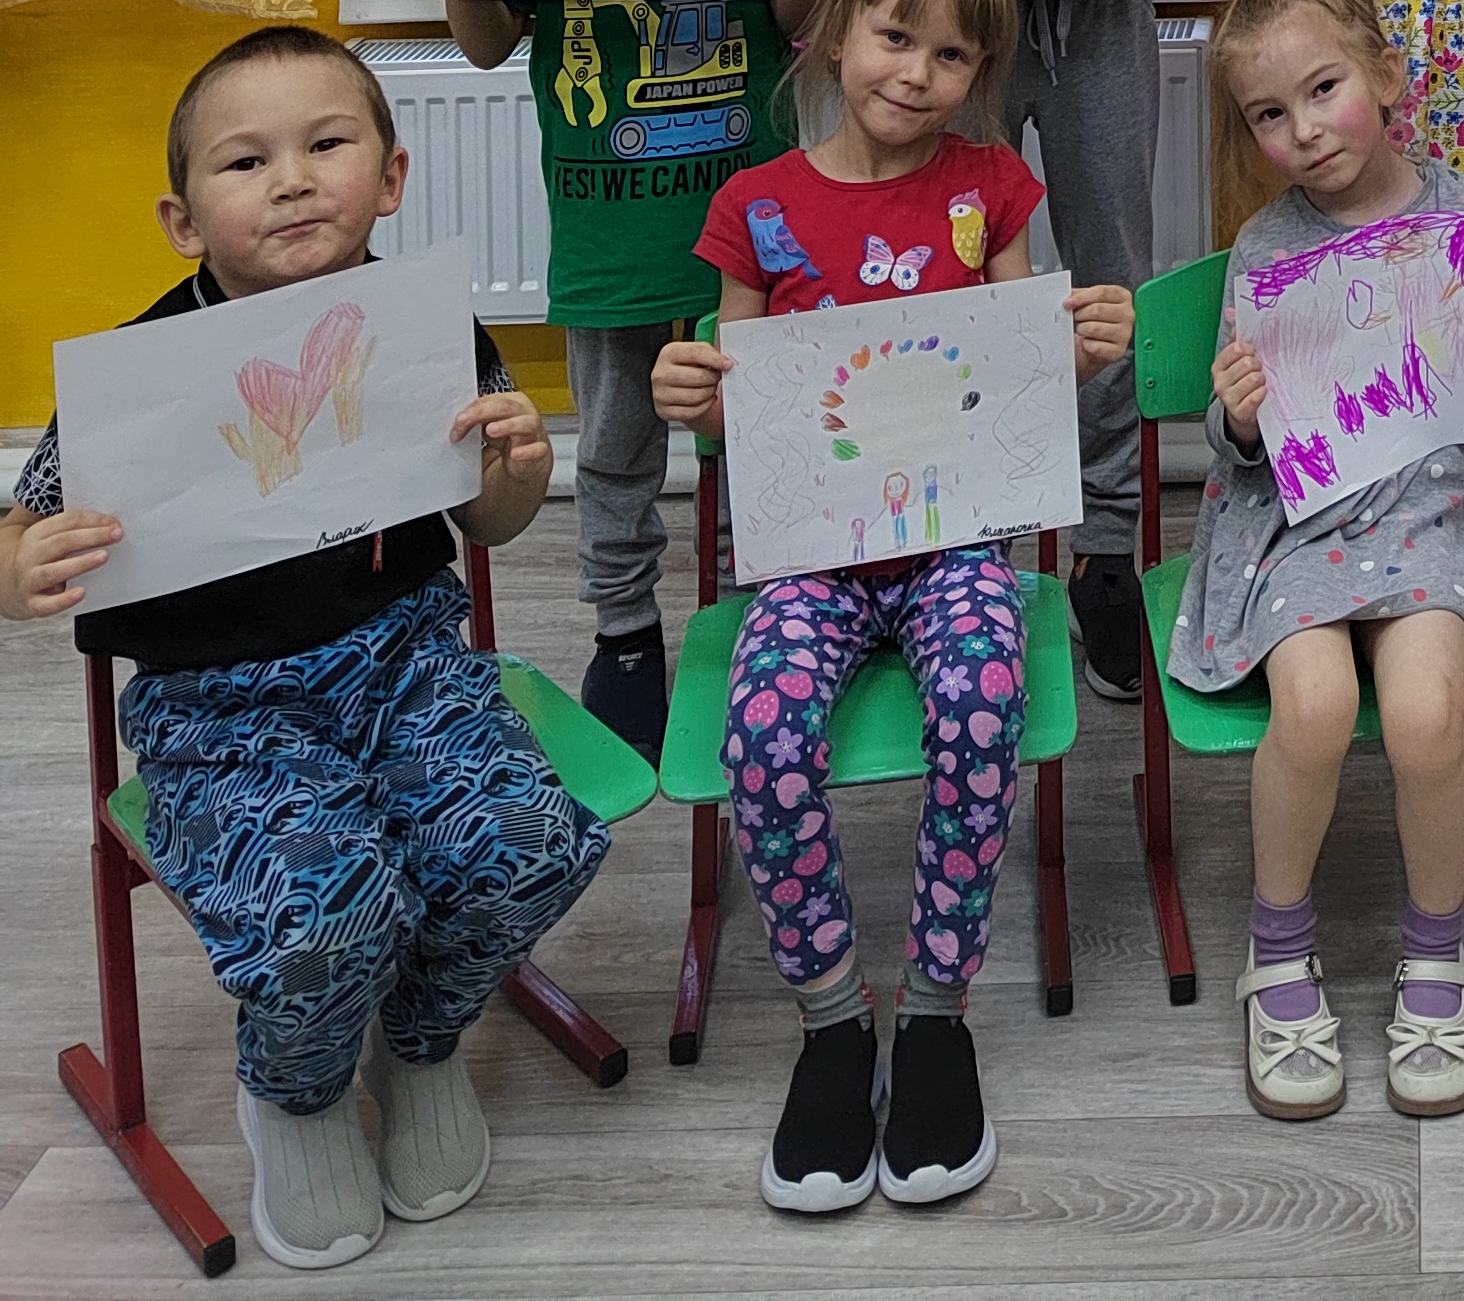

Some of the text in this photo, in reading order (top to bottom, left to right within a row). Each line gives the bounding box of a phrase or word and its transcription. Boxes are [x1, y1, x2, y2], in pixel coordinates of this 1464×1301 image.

[645, 75, 744, 100] JAPAN POWER
[602, 167, 646, 202] WE
[651, 159, 713, 199] CAN
